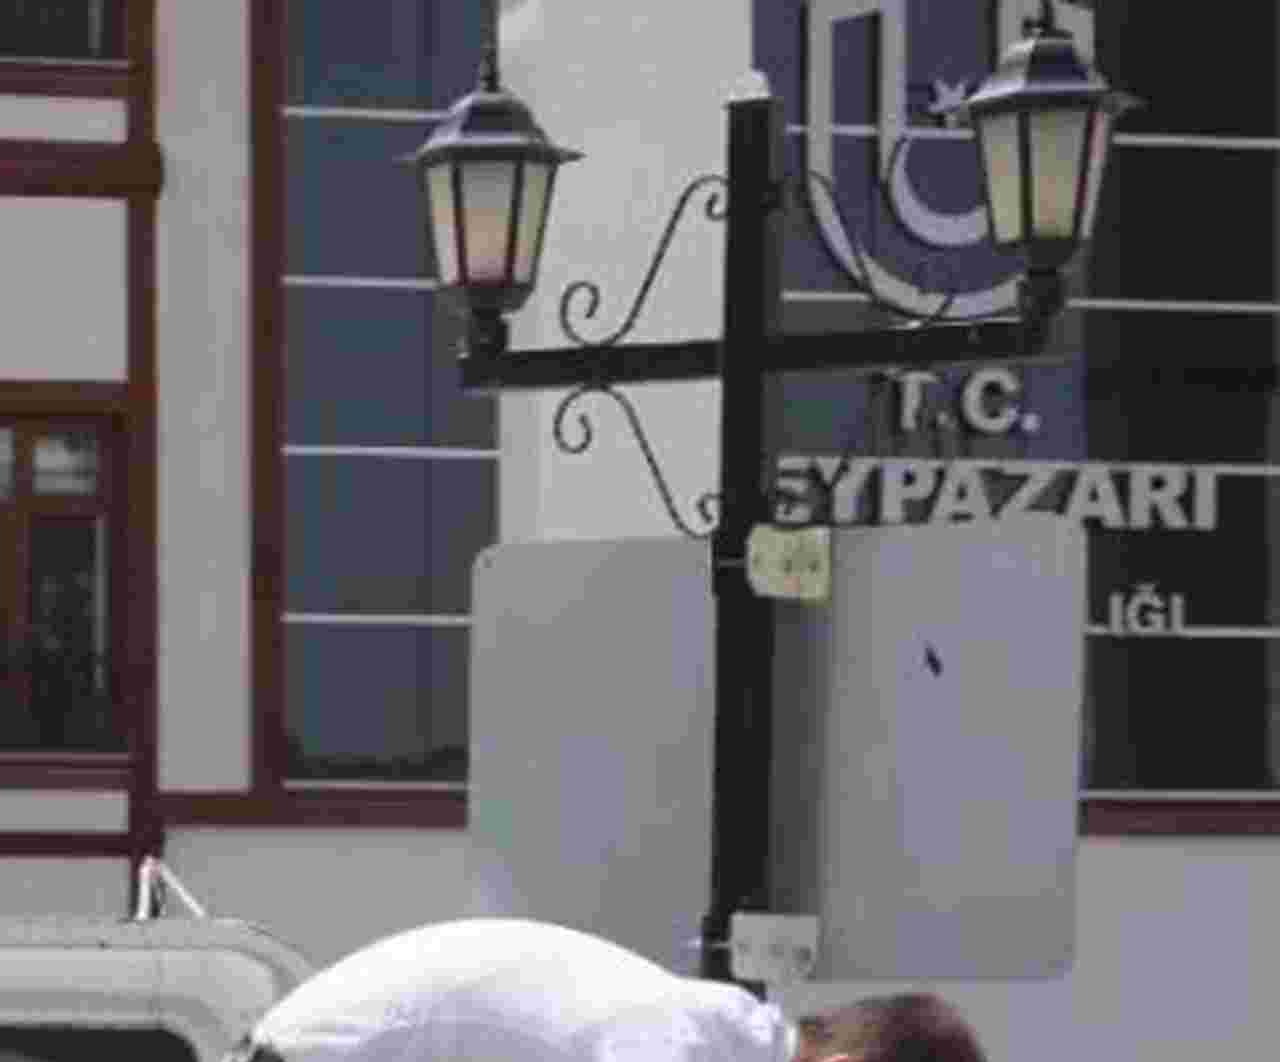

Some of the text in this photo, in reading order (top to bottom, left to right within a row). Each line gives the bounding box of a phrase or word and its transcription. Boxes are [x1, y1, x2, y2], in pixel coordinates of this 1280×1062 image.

[894, 369, 1042, 432] T.C.
[775, 457, 1217, 530] EYPAZARI
[1108, 582, 1185, 636] IĞI
